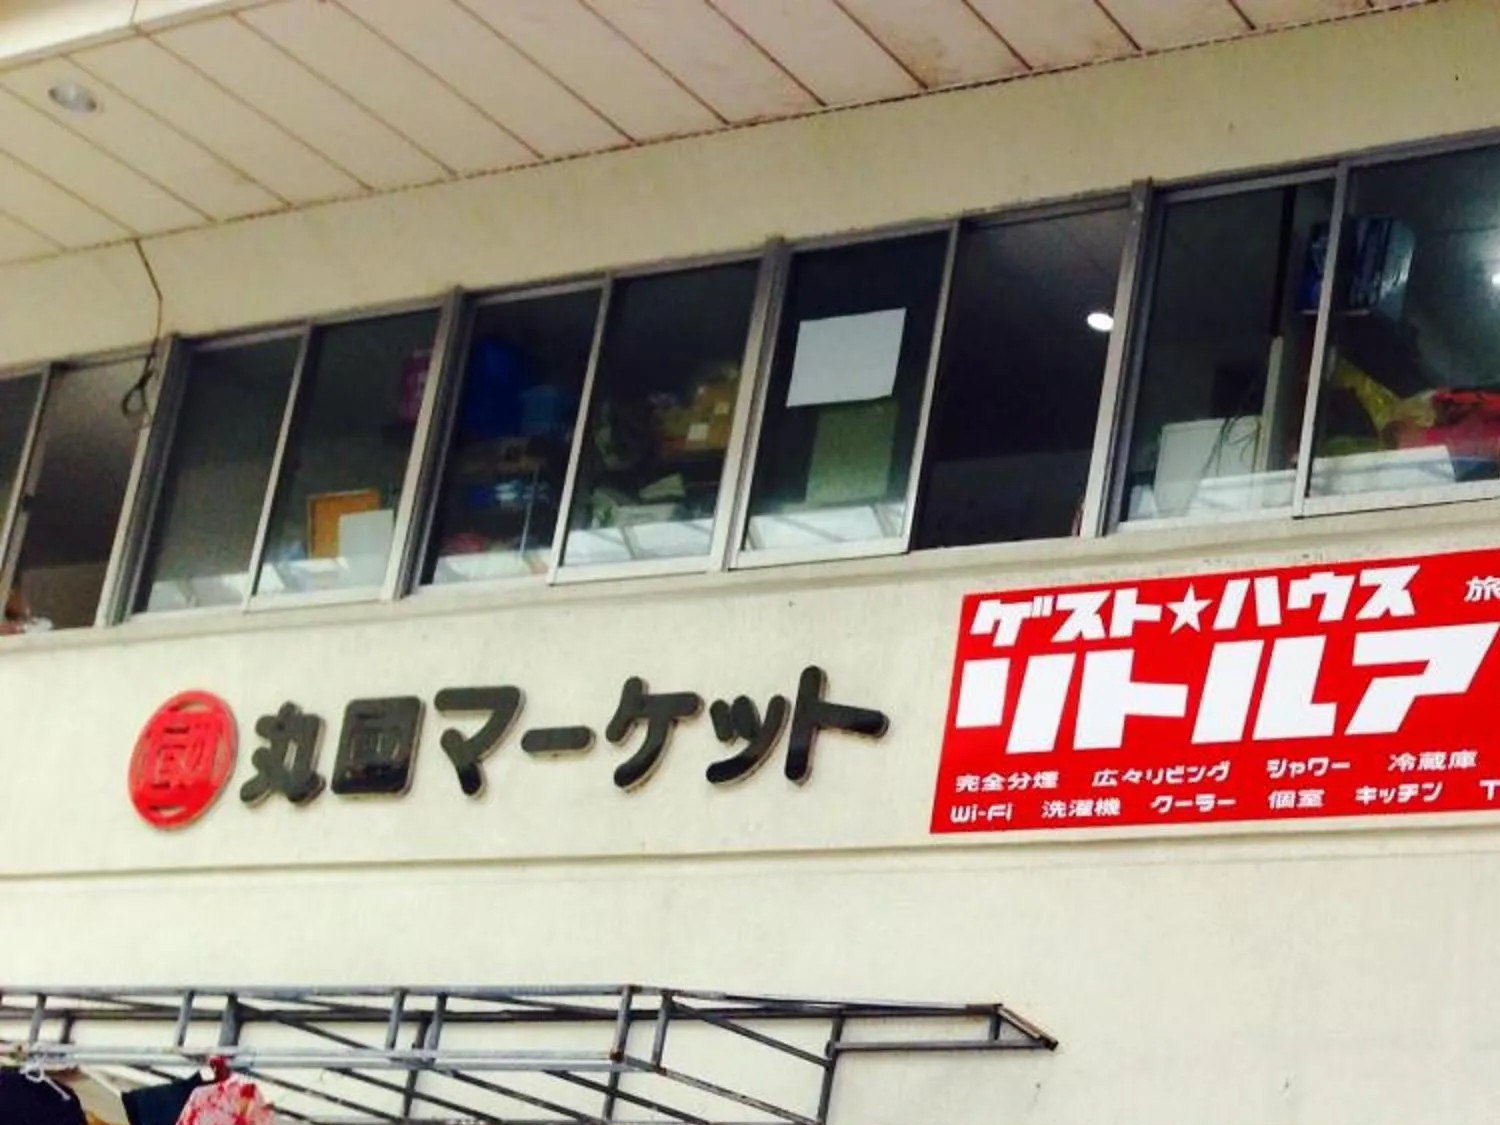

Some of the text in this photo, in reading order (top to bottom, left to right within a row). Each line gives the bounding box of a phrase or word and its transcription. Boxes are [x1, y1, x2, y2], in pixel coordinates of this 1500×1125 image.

[955, 770, 1059, 792] 完全分煙
[1092, 760, 1231, 787] 広々リビング
[1266, 756, 1350, 779] シャワー
[1388, 750, 1478, 772] 冷蔵庫
[950, 802, 1013, 824] Wi-Fi
[1041, 797, 1121, 819] 洗濯機
[1151, 793, 1236, 813] クーラー
[1267, 788, 1325, 809] 個室
[1356, 781, 1443, 804] キッチン
